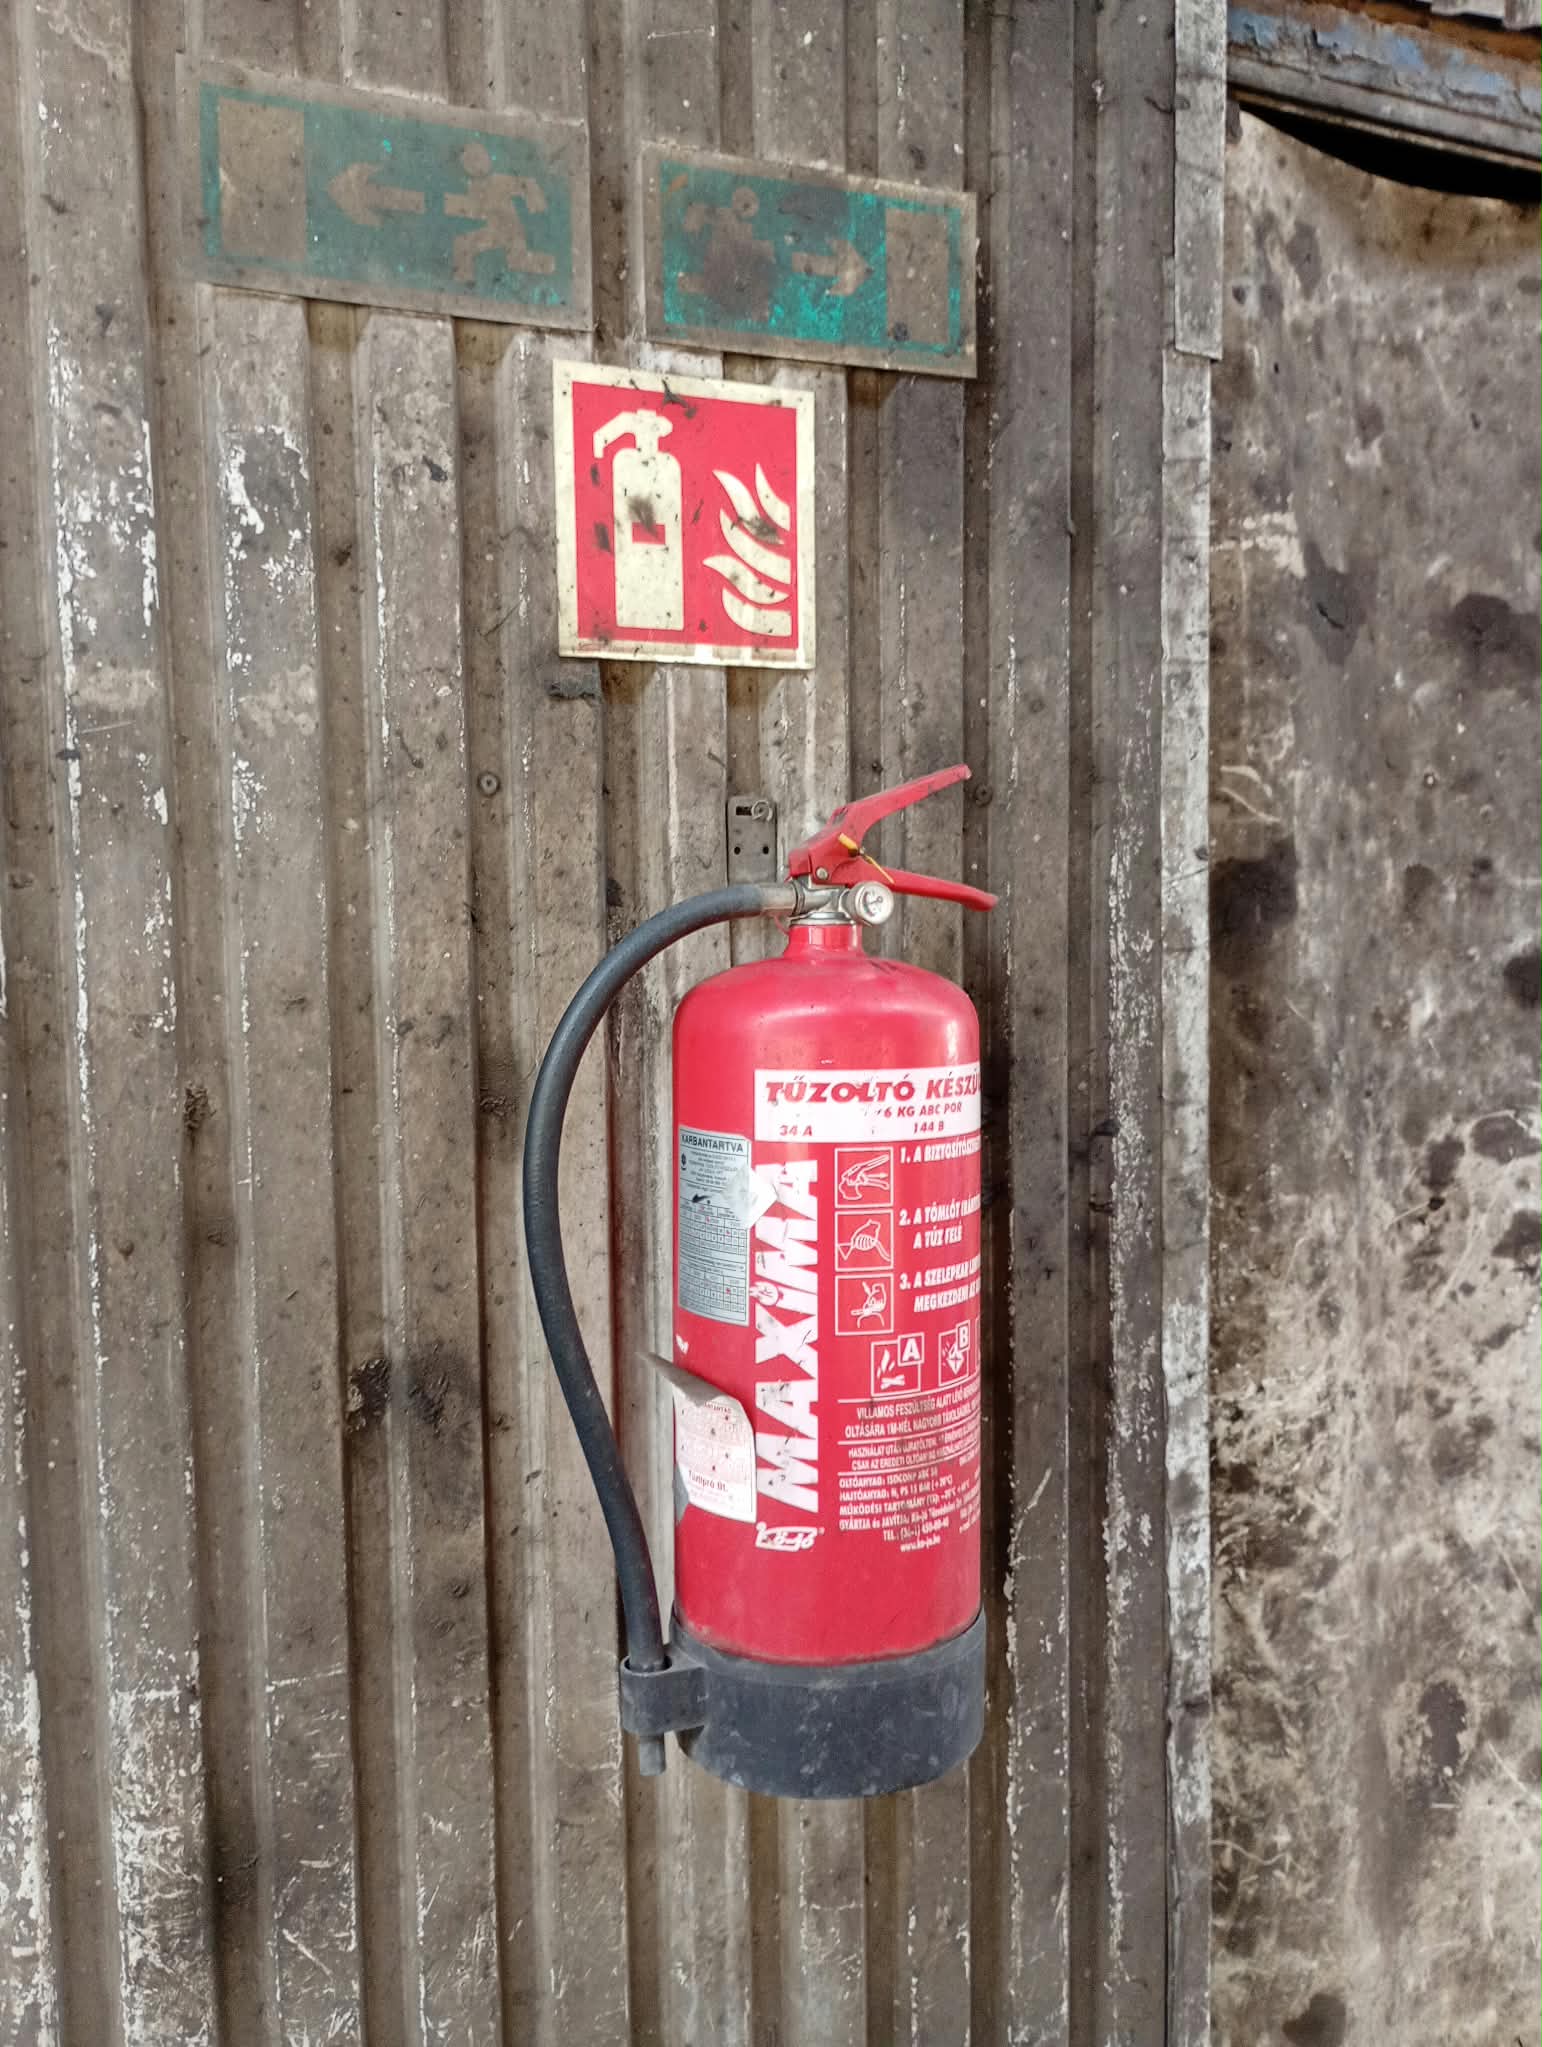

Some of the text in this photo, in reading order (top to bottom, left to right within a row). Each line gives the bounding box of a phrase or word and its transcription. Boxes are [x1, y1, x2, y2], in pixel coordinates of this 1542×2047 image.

[766, 1067, 980, 1102] TŰZOLTÓ KÉSZÜ
[884, 1101, 962, 1118] 6 KG ABC POR
[780, 1124, 799, 1137] 34
[802, 1124, 813, 1137] A
[938, 1120, 945, 1132] B
[900, 1145, 911, 1164] 1.
[913, 1145, 922, 1163] A
[899, 1208, 911, 1226] 2.
[913, 1207, 922, 1225] A
[913, 1231, 922, 1249] A
[899, 1272, 911, 1290] 3.
[913, 1271, 922, 1289] A
[959, 1325, 968, 1349] B
[902, 1338, 921, 1362] A
[857, 1403, 895, 1420] VILLAMOS
[844, 1420, 886, 1439] OLTÁSÁRA
